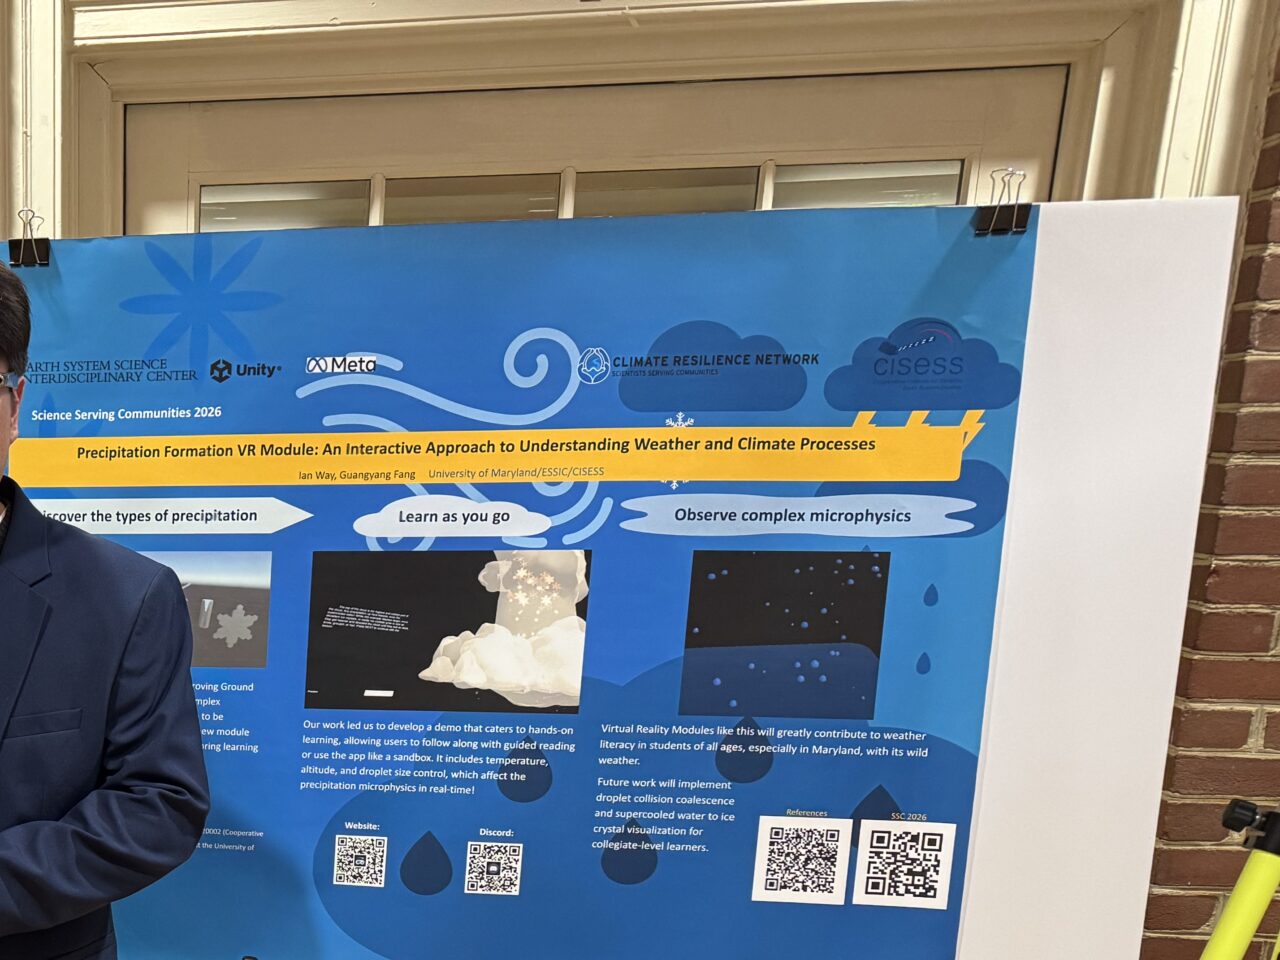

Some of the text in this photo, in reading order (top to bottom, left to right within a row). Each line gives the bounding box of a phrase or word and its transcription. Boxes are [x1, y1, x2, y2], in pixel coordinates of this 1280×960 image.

[27, 358, 167, 372] ARTH SYSTEM SCIENCE
[331, 356, 376, 372] Meta
[613, 353, 819, 367] CLIMATE RESILIENCE NETWORK
[873, 356, 964, 377] cisess
[23, 370, 198, 384] NTERDISCIPLINARY CENTER
[31, 406, 222, 422] Science Serving Communities 2026
[77, 436, 876, 462] Precipitation Formation VR Module: An Interactive Approach to Understanding Weather and Climate Processes
[298, 469, 416, 482] Ian Way, Guangyang Fang
[428, 466, 605, 480] University of Maryland/ESSIC/CISESS
[90, 508, 258, 525] the types of precipitation
[398, 510, 510, 526] Learn as you go
[674, 507, 911, 526] Observe complex microphysics
[220, 682, 254, 692] Ground
[201, 711, 224, 721] to be
[216, 727, 250, 737] module
[303, 719, 321, 729] Our
[322, 720, 345, 730] work
[346, 720, 362, 730] led
[375, 722, 386, 731] to
[387, 721, 425, 733] develop
[426, 724, 433, 732] a
[434, 722, 462, 732] demo
[463, 723, 483, 733] that
[484, 725, 514, 734] caters
[515, 725, 527, 734] to
[528, 724, 574, 735] hands-on
[601, 723, 927, 741] Virtual Reality Modules like this will greatly contribute to weather
[223, 742, 259, 754] learning
[302, 734, 576, 753] learning, allowing users to follow along with guided reading
[599, 739, 929, 758] literacy in students of all ages, especially in Maryland, with its wild
[301, 751, 312, 759] or
[313, 752, 330, 760] use
[331, 750, 347, 760] the
[348, 753, 366, 762] app
[367, 751, 384, 761] like
[393, 752, 434, 762] sandbox.
[436, 754, 444, 763] It
[445, 754, 484, 764] includes
[485, 756, 549, 768] temperature,
[598, 755, 641, 766] weather.
[300, 764, 527, 781] altitude, and droplet size control, which affect the
[299, 780, 475, 795] precipitation microphysics in real-time!
[597, 777, 733, 791] Future work will implement
[595, 792, 735, 806] droplet collision coalescence
[594, 808, 736, 822] and supercooled water to ice
[786, 808, 828, 817] References
[891, 812, 927, 821] SSC 2026
[344, 821, 380, 831] Website:
[479, 827, 514, 837] Discord:
[593, 824, 704, 836] crystal visualization for
[591, 839, 709, 852] collegiate-level learners.
